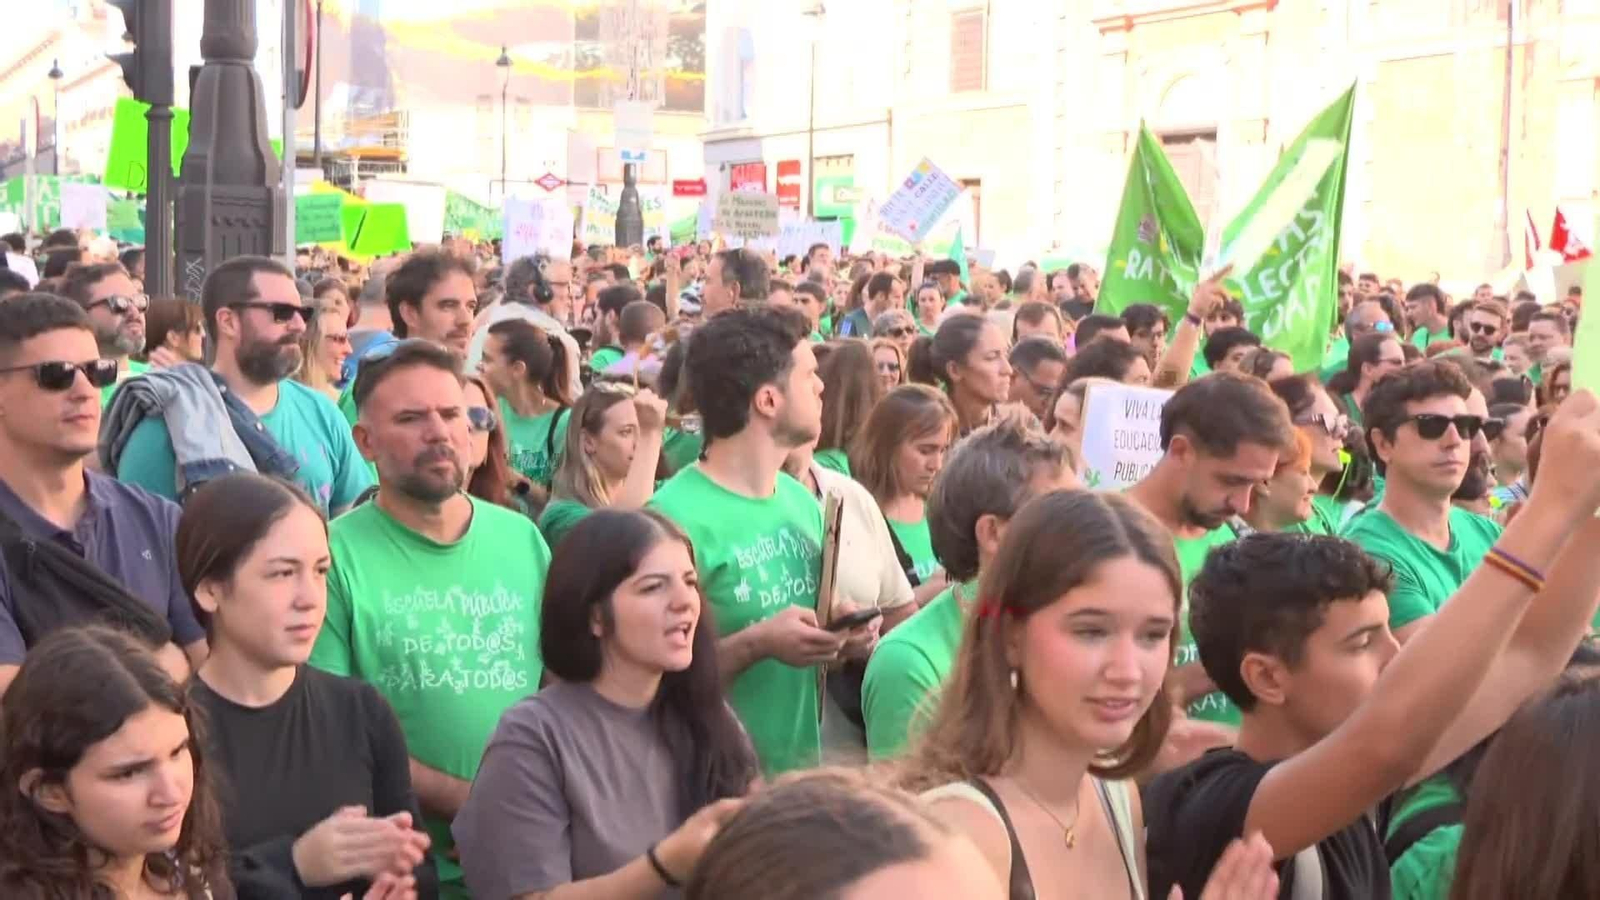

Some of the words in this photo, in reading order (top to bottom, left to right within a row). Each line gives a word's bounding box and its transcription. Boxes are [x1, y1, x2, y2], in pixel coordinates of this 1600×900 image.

[1124, 398, 1148, 420] VIVA
[759, 586, 781, 608] DE
[403, 633, 433, 654] DE
